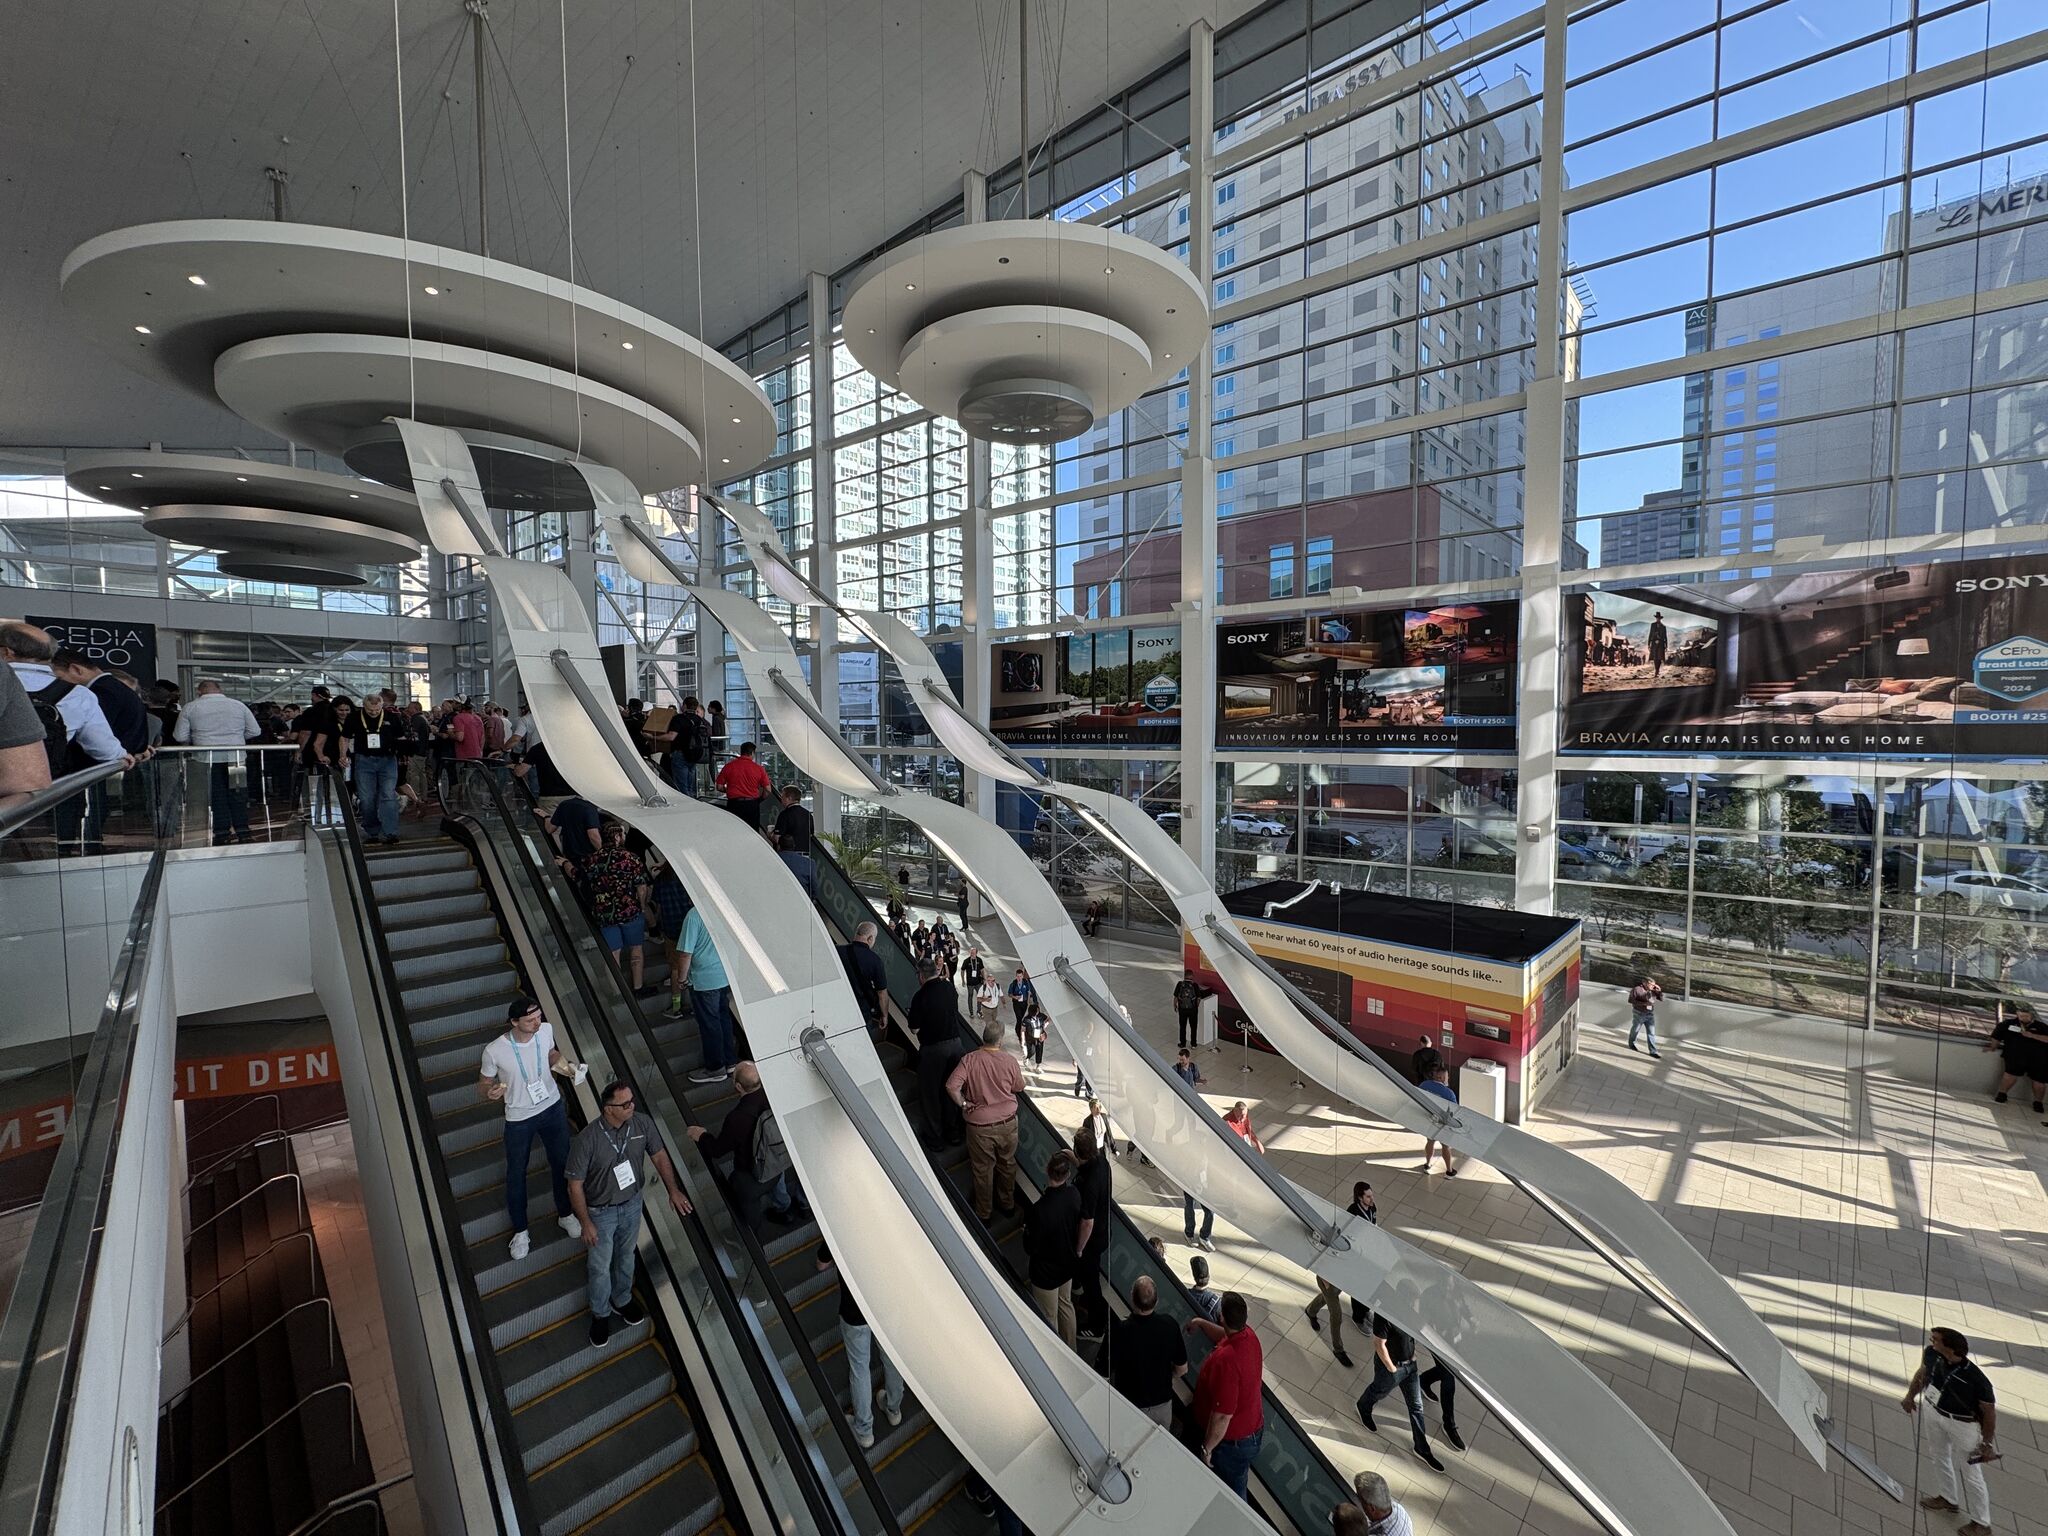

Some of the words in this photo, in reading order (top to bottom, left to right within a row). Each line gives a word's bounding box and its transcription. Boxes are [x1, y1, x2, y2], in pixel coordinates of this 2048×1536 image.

[1936, 205, 1973, 232] Le
[1979, 184, 2048, 219] MER
[1137, 638, 1175, 648] SONY
[1227, 633, 1270, 644] SONY
[1999, 646, 2041, 656] CEPro
[1978, 660, 2016, 669] Brand
[1970, 713, 2018, 721] BOOTH
[1423, 734, 1459, 742] ROOM
[1579, 732, 1650, 744] BRAVIA
[1662, 735, 1730, 744] CINEMA
[1743, 735, 1759, 744] IS
[1771, 735, 1851, 745] COMING
[1865, 735, 1925, 745] HOME
[1241, 926, 1265, 938] Come
[1265, 931, 1284, 942] hear
[1285, 935, 1307, 946] what
[1308, 939, 1320, 948] 60
[1321, 942, 1345, 954] years
[1346, 947, 1357, 955] of
[1358, 949, 1385, 960] audio
[1387, 954, 1429, 970] heritage
[1431, 963, 1470, 977] sounds
[1235, 1019, 1261, 1035] Celeb
[248, 1051, 329, 1087] DEN
